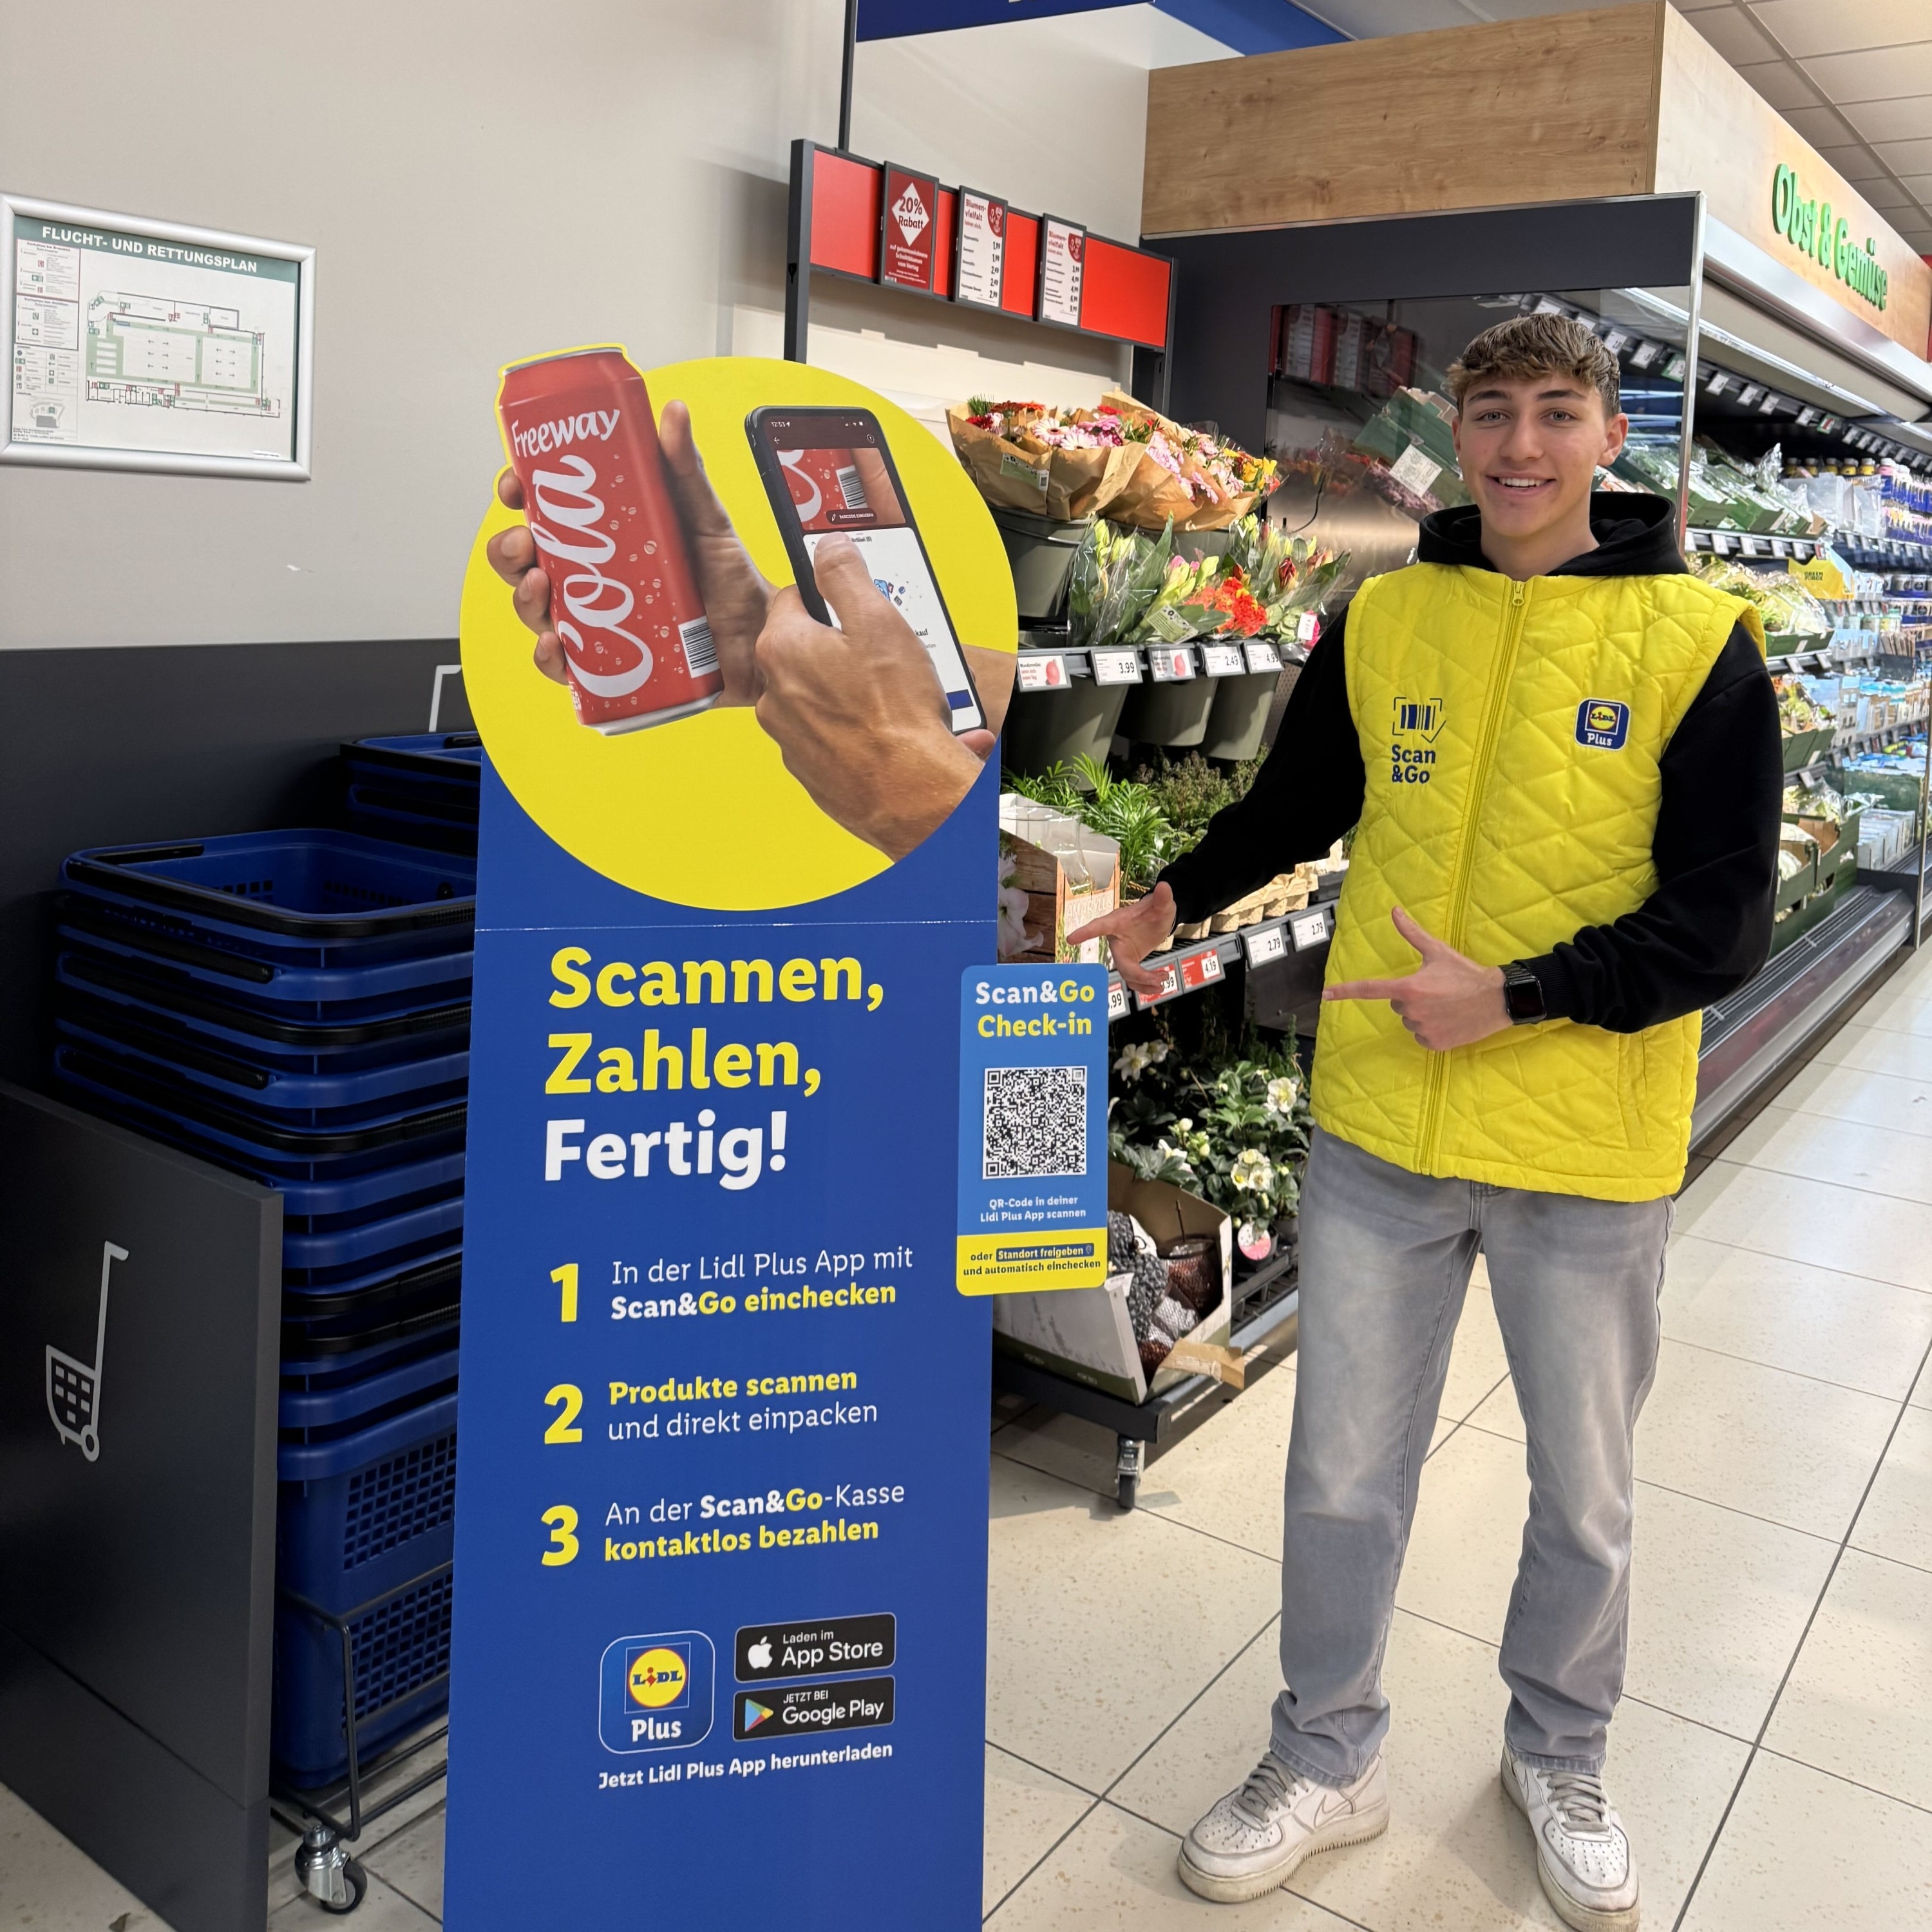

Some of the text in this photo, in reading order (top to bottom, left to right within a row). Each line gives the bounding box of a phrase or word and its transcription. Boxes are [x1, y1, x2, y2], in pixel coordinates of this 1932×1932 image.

[899, 196, 922, 215] 20%
[966, 199, 986, 211] Blumen-
[898, 215, 923, 229] Rabatt
[43, 226, 108, 247] FLUCHT-
[112, 238, 143, 254] UND
[147, 244, 257, 272] RETTUNGSPLAN
[1772, 164, 1888, 311] Obst & Gemüse
[511, 409, 620, 458] Freeway
[531, 455, 653, 697] Cola
[1119, 662, 1134, 674] 3.99
[1225, 655, 1238, 666] 2.49
[1587, 732, 1613, 747] Plus
[1391, 744, 1436, 764] Scan
[1391, 764, 1430, 784] &Go
[1312, 922, 1323, 935] 2.79
[1267, 937, 1281, 952] 2.79
[549, 946, 884, 1012] Scannen,
[1205, 961, 1217, 973] 4.19
[976, 980, 1095, 1005] Scan&Go
[1108, 992, 1122, 1009] .99
[978, 1012, 1092, 1038] Check-in
[545, 1028, 820, 1097] Zahlen,
[545, 1109, 787, 1190] Fertig!
[989, 1195, 1078, 1209] QR-Code in deiner
[980, 1209, 1086, 1222] Lidl Plus App scannen
[612, 1246, 913, 1285] In der Lidl Plus App mit
[970, 1245, 1084, 1261] oder Standort freigeben
[963, 1259, 1101, 1276] und automatisch einchecken
[550, 1263, 579, 1323] 1
[611, 1282, 896, 1320] Scan&Go einchecken
[609, 1370, 857, 1405] Produkte scannen
[544, 1383, 583, 1444] 2
[608, 1401, 877, 1441] und direkt einpacken
[605, 1483, 905, 1526] An der Scan&Go-Kasse
[541, 1504, 579, 1566] 3
[605, 1519, 878, 1562] kontaktlos bezahlen
[783, 1629, 834, 1644] Laden im
[781, 1640, 883, 1669] App Store
[783, 1690, 828, 1704] JETZT BEI
[782, 1699, 884, 1726] Google Play
[631, 1717, 681, 1743] Plus
[598, 1743, 893, 1790] Jetzt Lidl Plus App herunterladen
